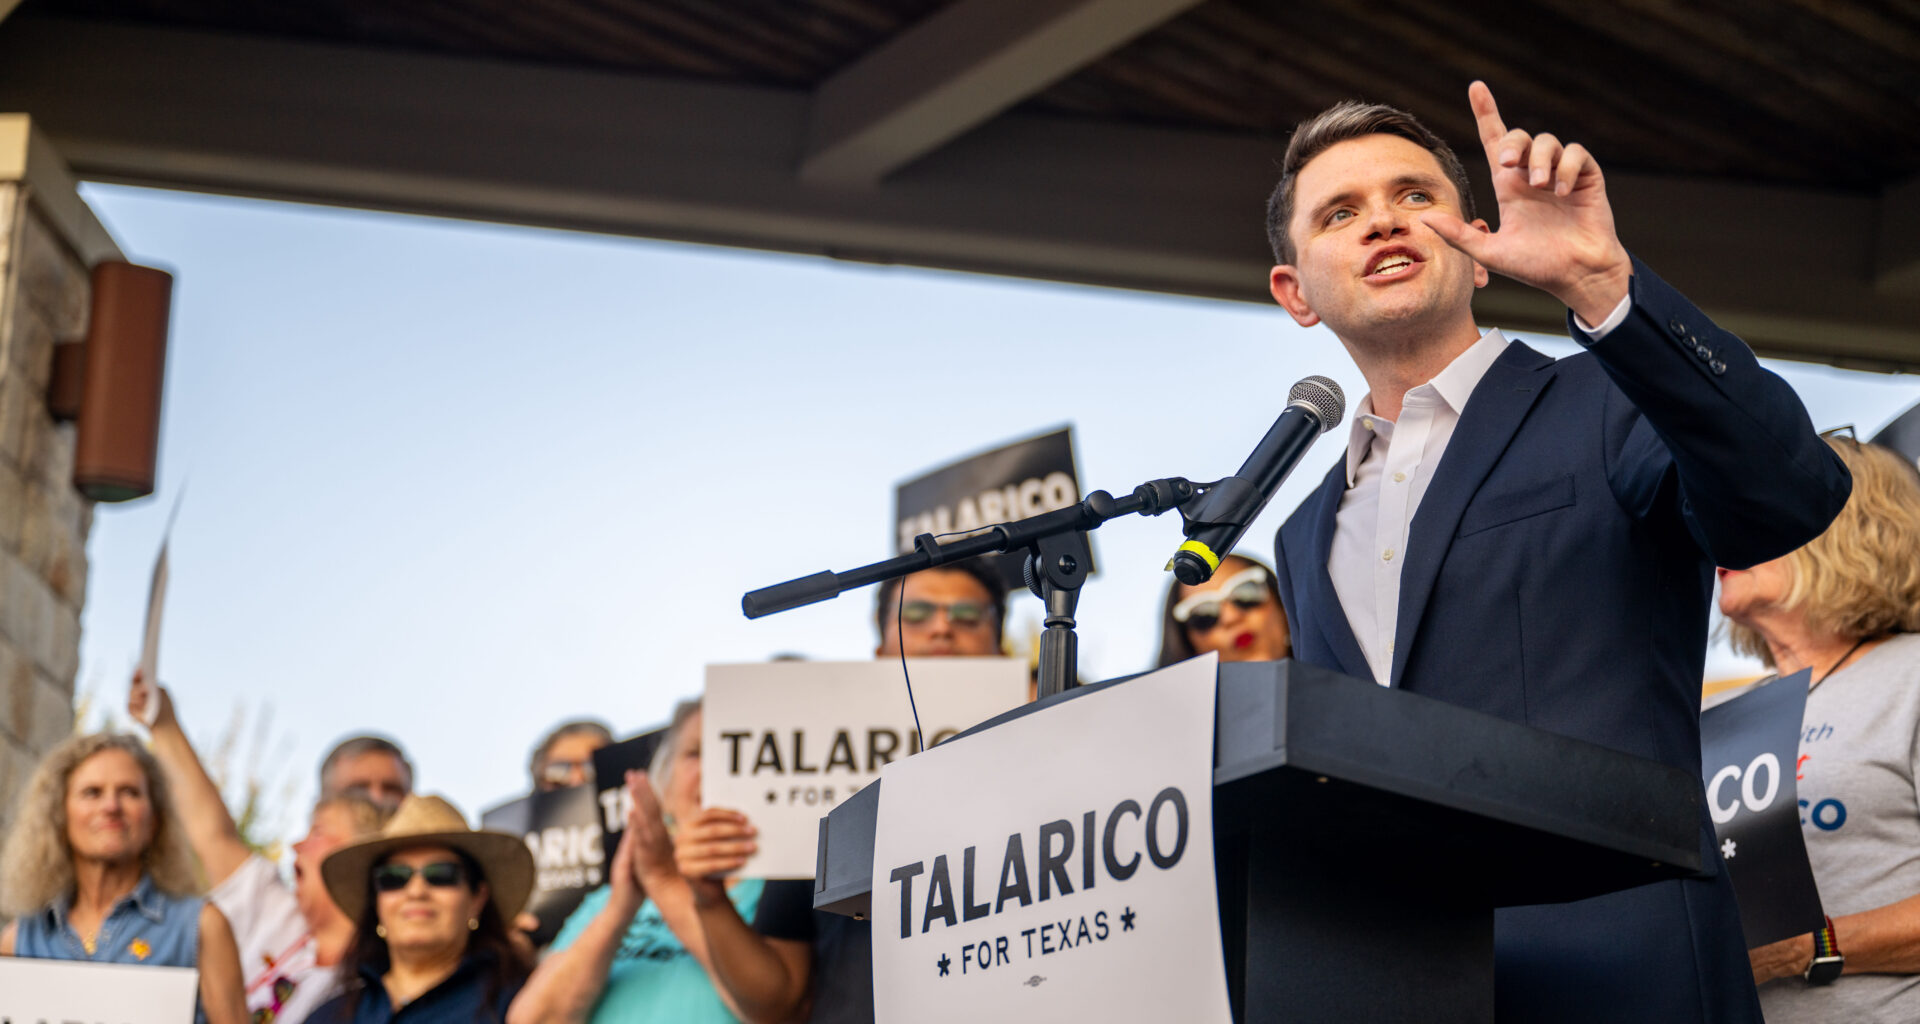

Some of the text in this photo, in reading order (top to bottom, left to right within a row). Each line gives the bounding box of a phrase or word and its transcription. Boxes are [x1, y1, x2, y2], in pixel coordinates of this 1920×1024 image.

[788, 787, 836, 806] FOR
[1706, 752, 1780, 824] CO
[889, 786, 1190, 940] TALARICO
[961, 910, 1110, 976] FOR TEXAS
